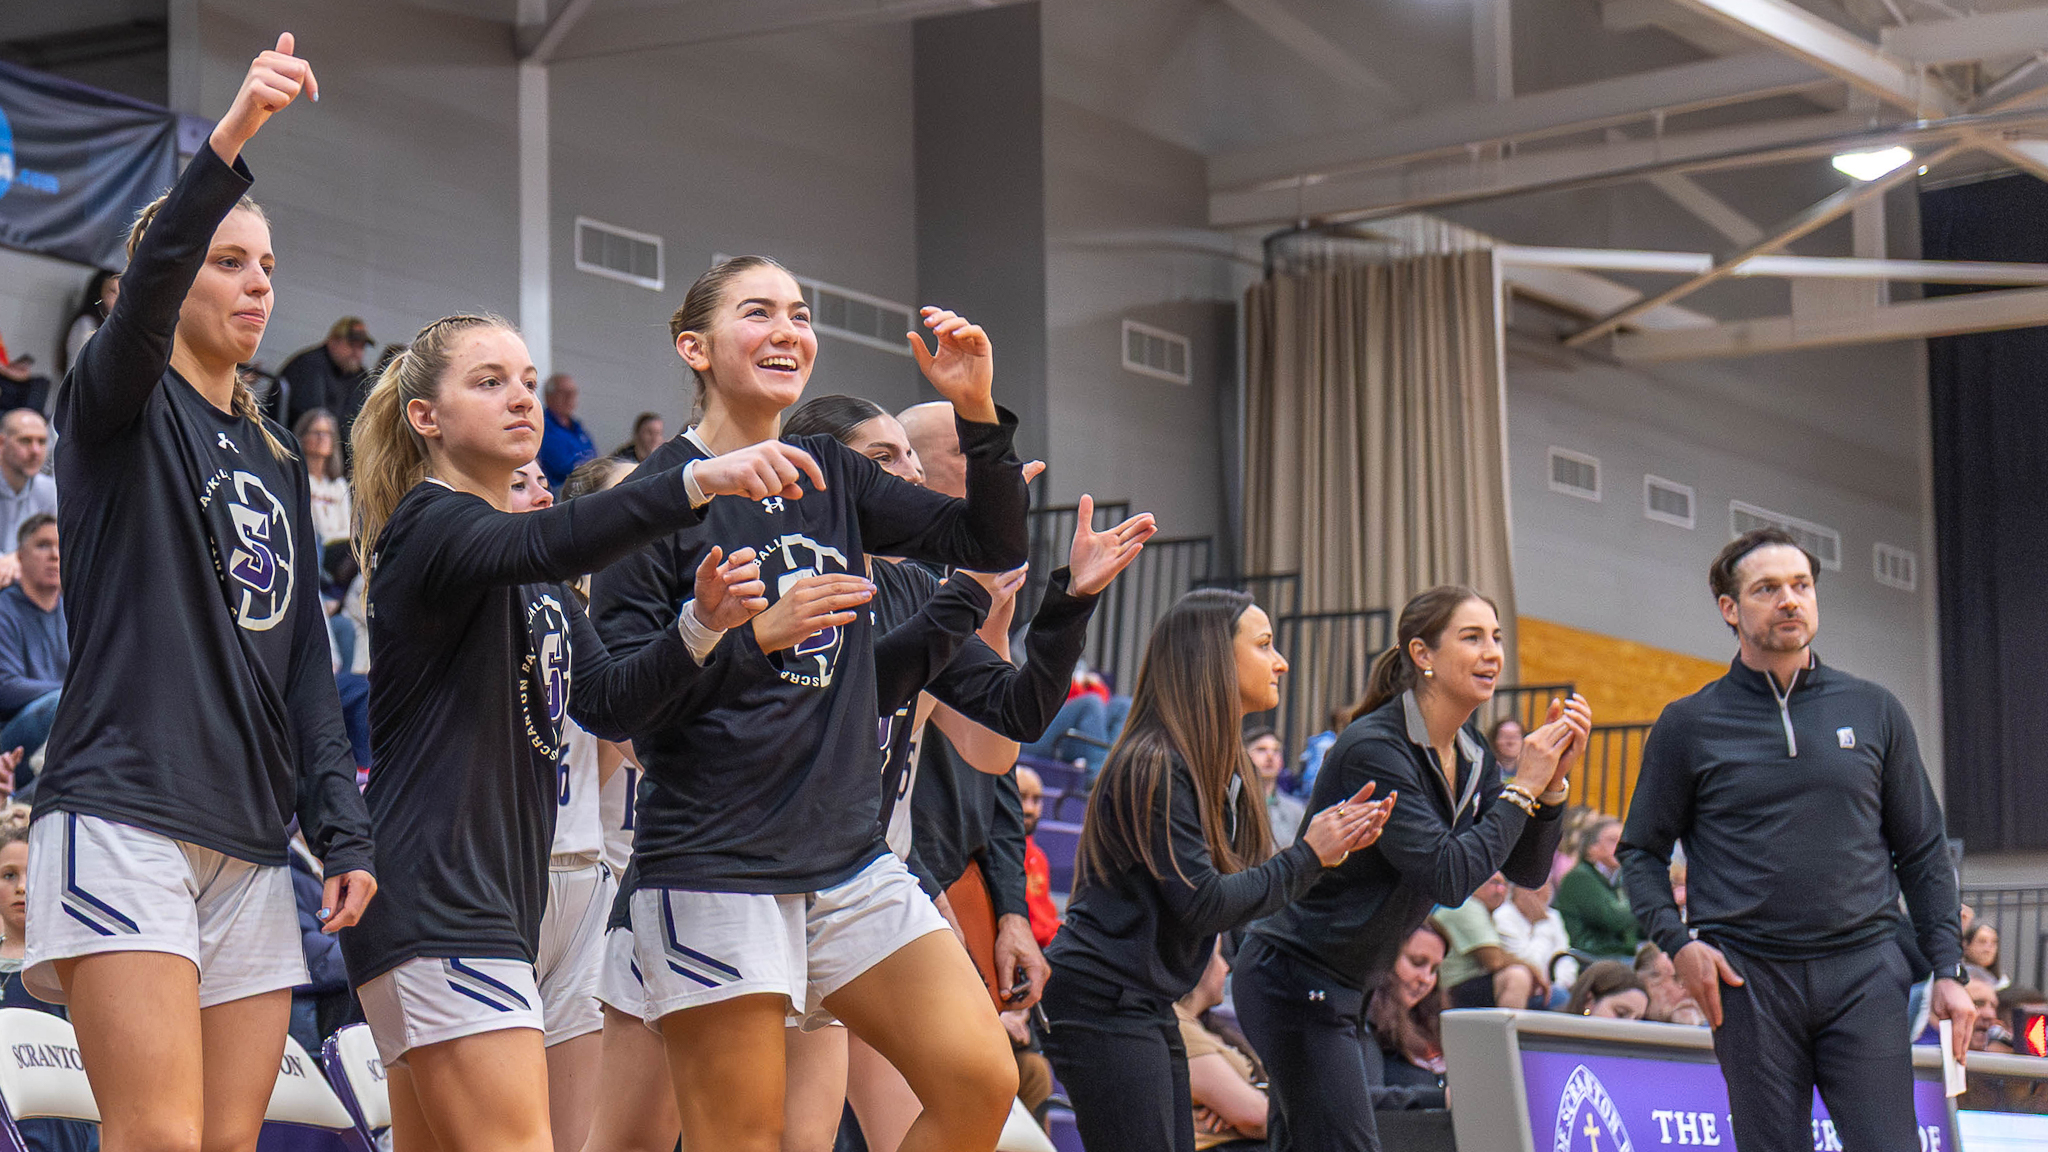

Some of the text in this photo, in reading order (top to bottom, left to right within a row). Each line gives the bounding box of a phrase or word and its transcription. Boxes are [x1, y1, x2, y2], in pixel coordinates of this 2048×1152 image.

[12, 1043, 84, 1071] SCRANTO
[280, 1053, 306, 1079] ON
[1651, 1109, 1721, 1146] THE
